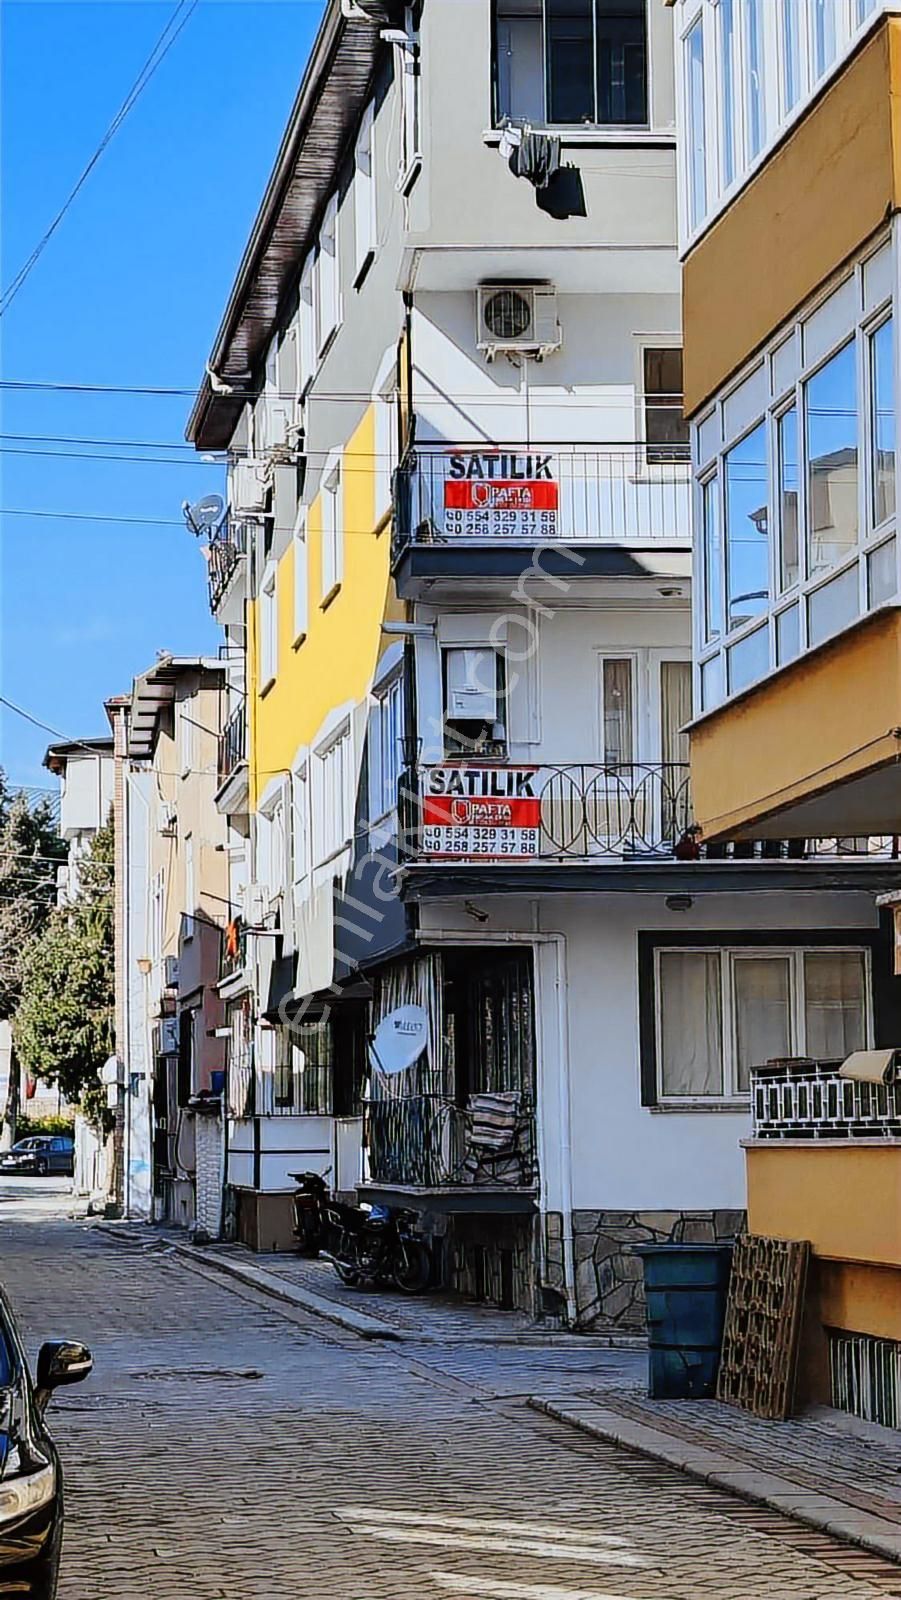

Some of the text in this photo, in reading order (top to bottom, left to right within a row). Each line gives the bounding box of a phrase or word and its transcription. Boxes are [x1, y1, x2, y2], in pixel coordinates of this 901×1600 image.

[449, 454, 552, 479] SATILIK
[491, 487, 531, 497] PAFTA
[454, 511, 556, 522] 0 554 329 31 58
[454, 523, 556, 535] 0 258 257 57 88
[429, 769, 535, 797] SATILIK
[472, 803, 511, 815] PAFTA
[433, 827, 536, 841] 0 554 329 31 58
[433, 840, 536, 854] 0 258 257 57 88
